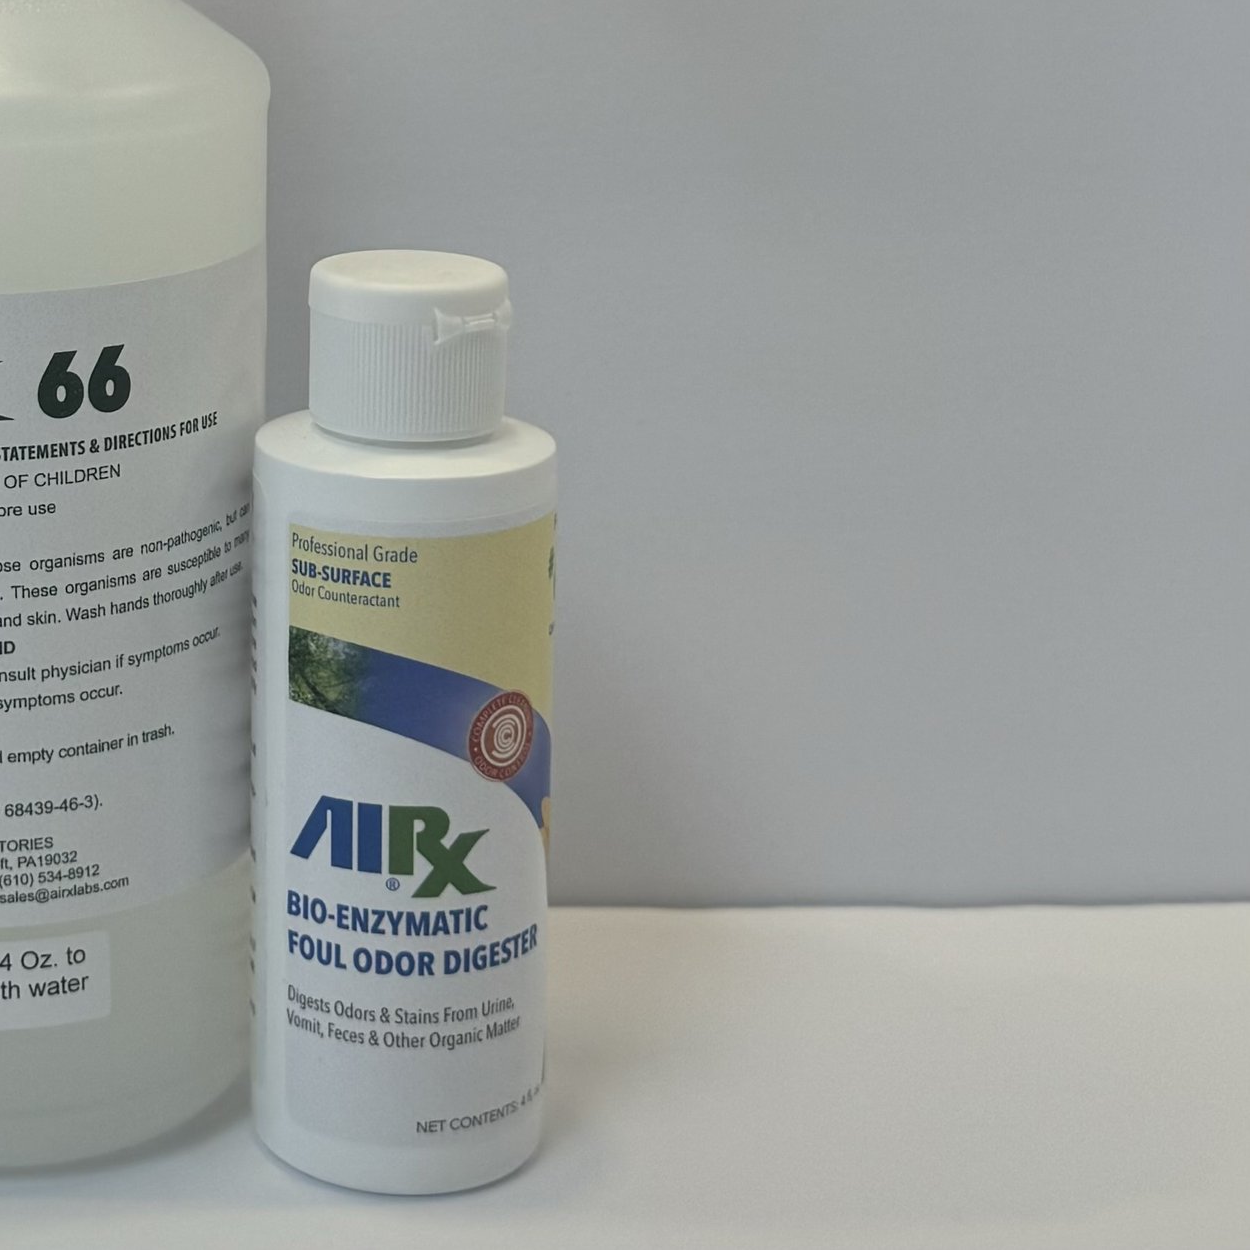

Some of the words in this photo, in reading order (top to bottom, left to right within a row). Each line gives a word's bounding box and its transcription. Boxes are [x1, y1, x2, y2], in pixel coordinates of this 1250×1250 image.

[38, 344, 131, 419] 66
[90, 439, 99, 453] &
[104, 424, 176, 451] DIRECTIONS
[180, 418, 198, 436] FOR
[202, 411, 217, 429] USE
[4, 474, 28, 489] OF
[34, 464, 120, 487] CHILDREN
[28, 503, 56, 515] use
[30, 552, 104, 572] organisms
[113, 547, 133, 560] are
[141, 521, 222, 558] non-pathogenic,
[292, 532, 368, 564] Professional
[373, 545, 417, 563] Grade
[11, 585, 57, 598] These
[65, 574, 136, 596] organisms
[143, 568, 161, 581] are
[168, 546, 221, 575] susceptible
[291, 558, 392, 589] SUB-SURFACE
[27, 612, 61, 625] skin.
[66, 604, 106, 621] Wash
[111, 596, 149, 615] hands
[153, 579, 207, 605] thoroughly
[210, 569, 228, 587] after
[292, 579, 315, 597] Odor
[318, 586, 400, 608] Counteractant
[41, 660, 111, 682] physician
[116, 654, 124, 668] if
[128, 640, 189, 667] symptoms
[193, 627, 221, 647] occur.
[80, 685, 122, 701] occur.
[7, 748, 54, 764] empty
[59, 738, 124, 758] container
[127, 734, 138, 746] in
[142, 724, 174, 743] trash.
[5, 794, 102, 817] 68439-46-3).
[18, 851, 77, 868] PA19032
[290, 795, 496, 898] AIRx
[0, 873, 34, 889] (610)
[38, 864, 99, 884] 534-8912
[287, 890, 488, 936] BIO-ENZYMATIC
[0, 953, 12, 971] 4
[21, 951, 57, 970] Oz.
[67, 947, 85, 965] to
[288, 929, 347, 970] FOUL
[353, 948, 434, 976] ODOR
[444, 921, 537, 975] DIGESTER
[29, 976, 89, 997] water
[287, 984, 330, 1016] Digests
[334, 1000, 376, 1022] Odors
[380, 1007, 390, 1023] &
[395, 1008, 439, 1025] Stains
[444, 1007, 477, 1022] From
[482, 998, 514, 1017] Urine,
[287, 1008, 324, 1038] Vomit,
[328, 1022, 364, 1044] Feces
[368, 1030, 379, 1046] &
[383, 1032, 425, 1048] Other
[429, 1030, 483, 1050] Organic
[486, 1016, 520, 1040] Matter
[416, 1120, 446, 1133] NET
